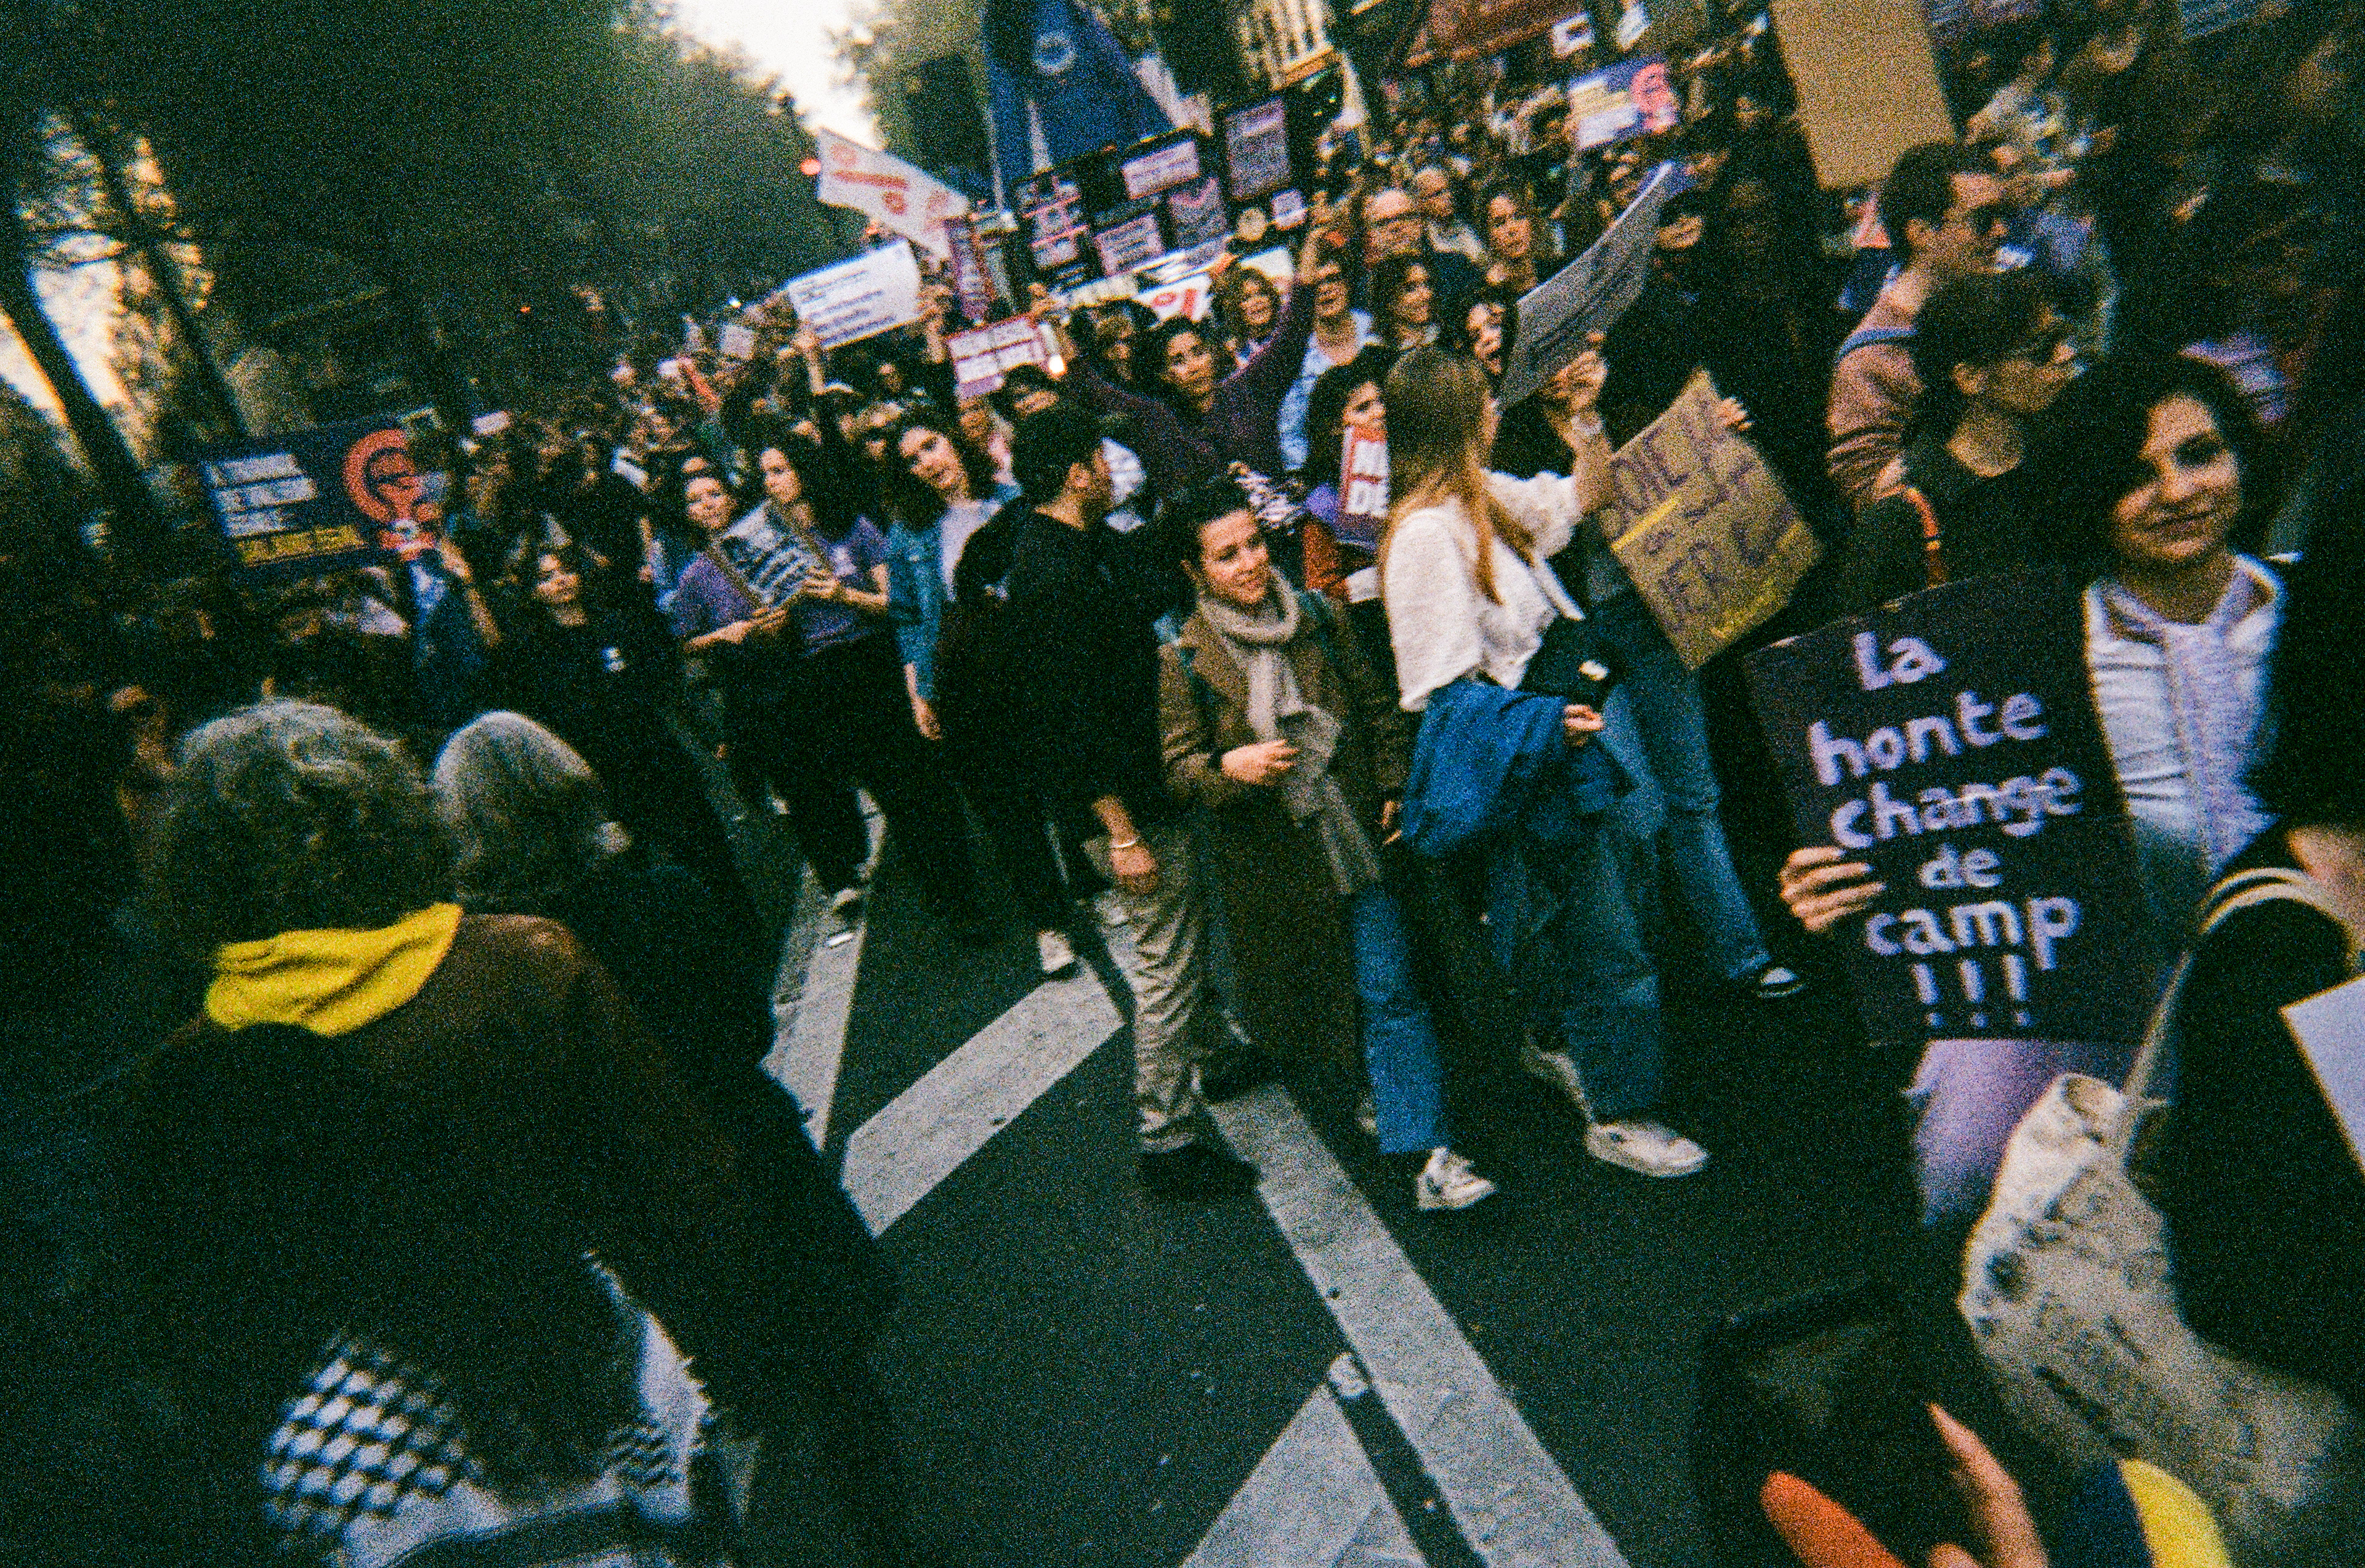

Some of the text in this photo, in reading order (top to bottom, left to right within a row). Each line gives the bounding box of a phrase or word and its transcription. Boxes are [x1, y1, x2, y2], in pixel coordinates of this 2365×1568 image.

[1853, 631, 1947, 691] La
[1806, 691, 2048, 786] honte
[1829, 766, 2082, 849] change
[1919, 844, 2002, 891] de
[1864, 897, 2079, 971] camp
[1910, 953, 2032, 1028] !!!
